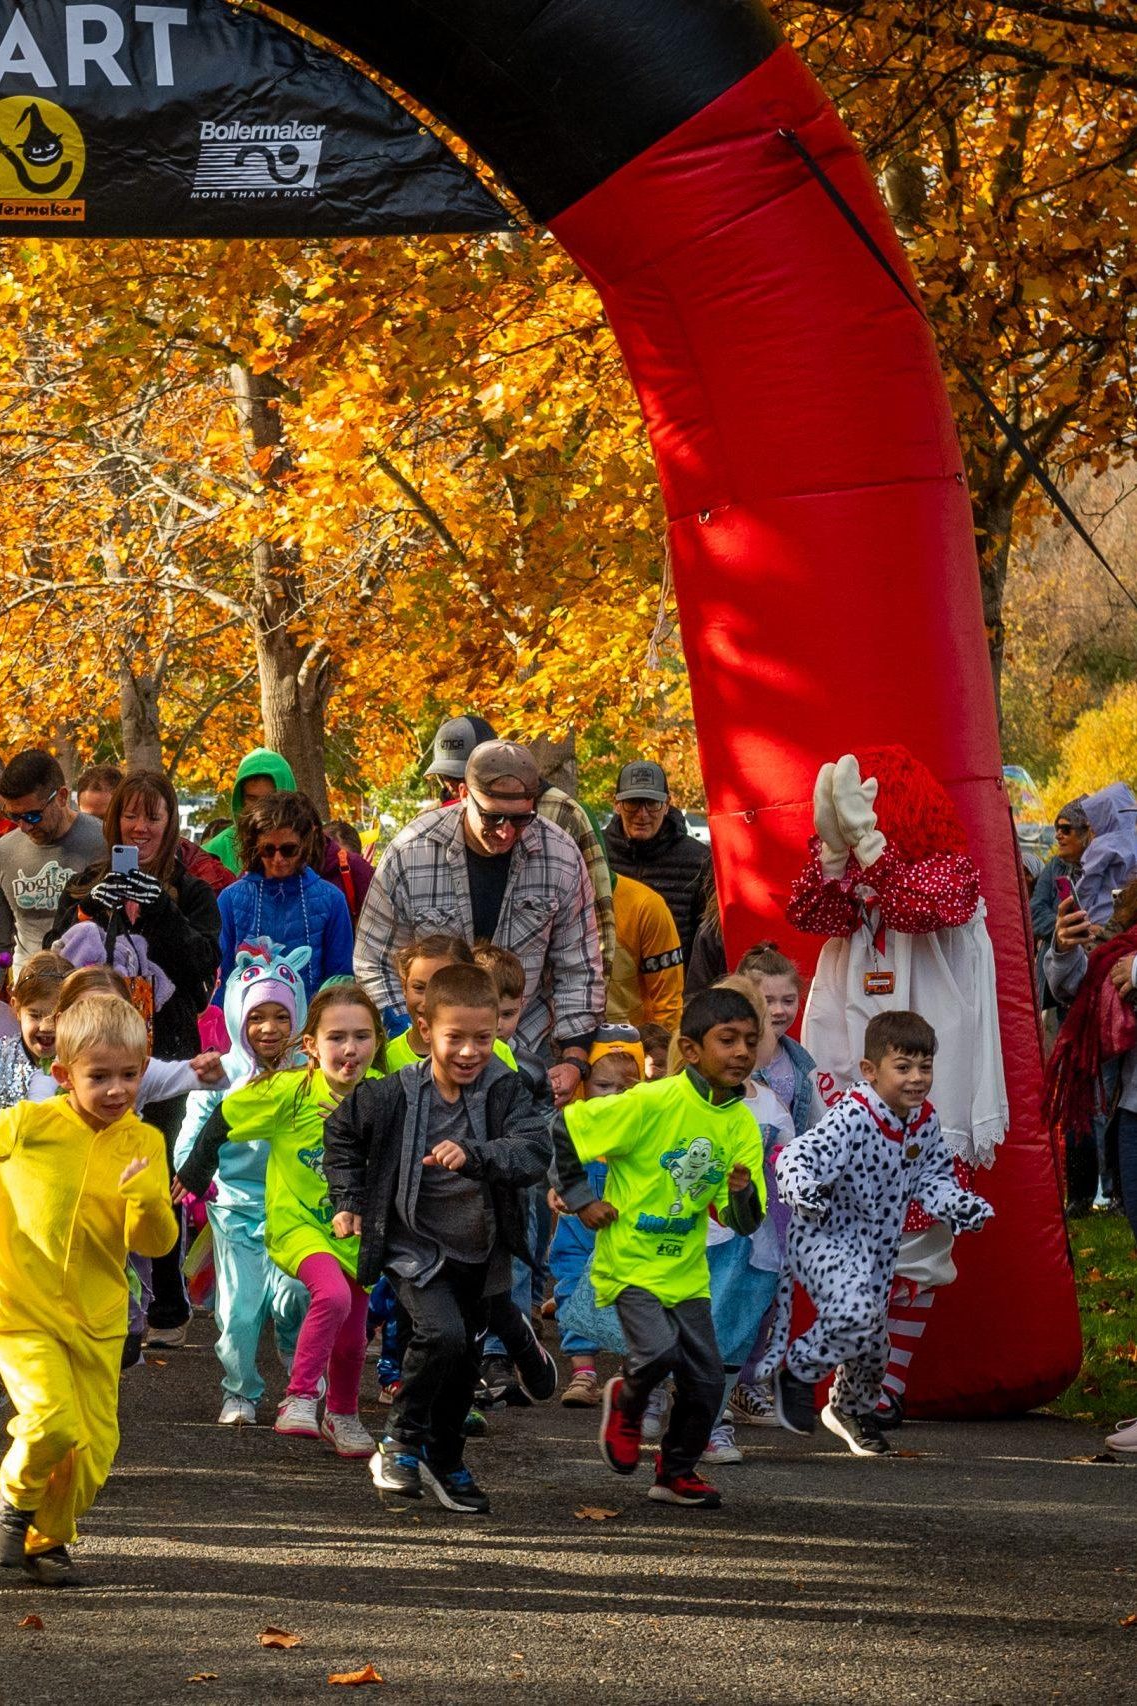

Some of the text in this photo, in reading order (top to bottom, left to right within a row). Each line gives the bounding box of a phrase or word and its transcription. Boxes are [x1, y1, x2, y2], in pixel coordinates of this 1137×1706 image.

[199, 120, 326, 140] Boilermaker
[190, 191, 225, 199] MORE
[232, 191, 265, 199] THAN
[283, 190, 316, 198] RACE
